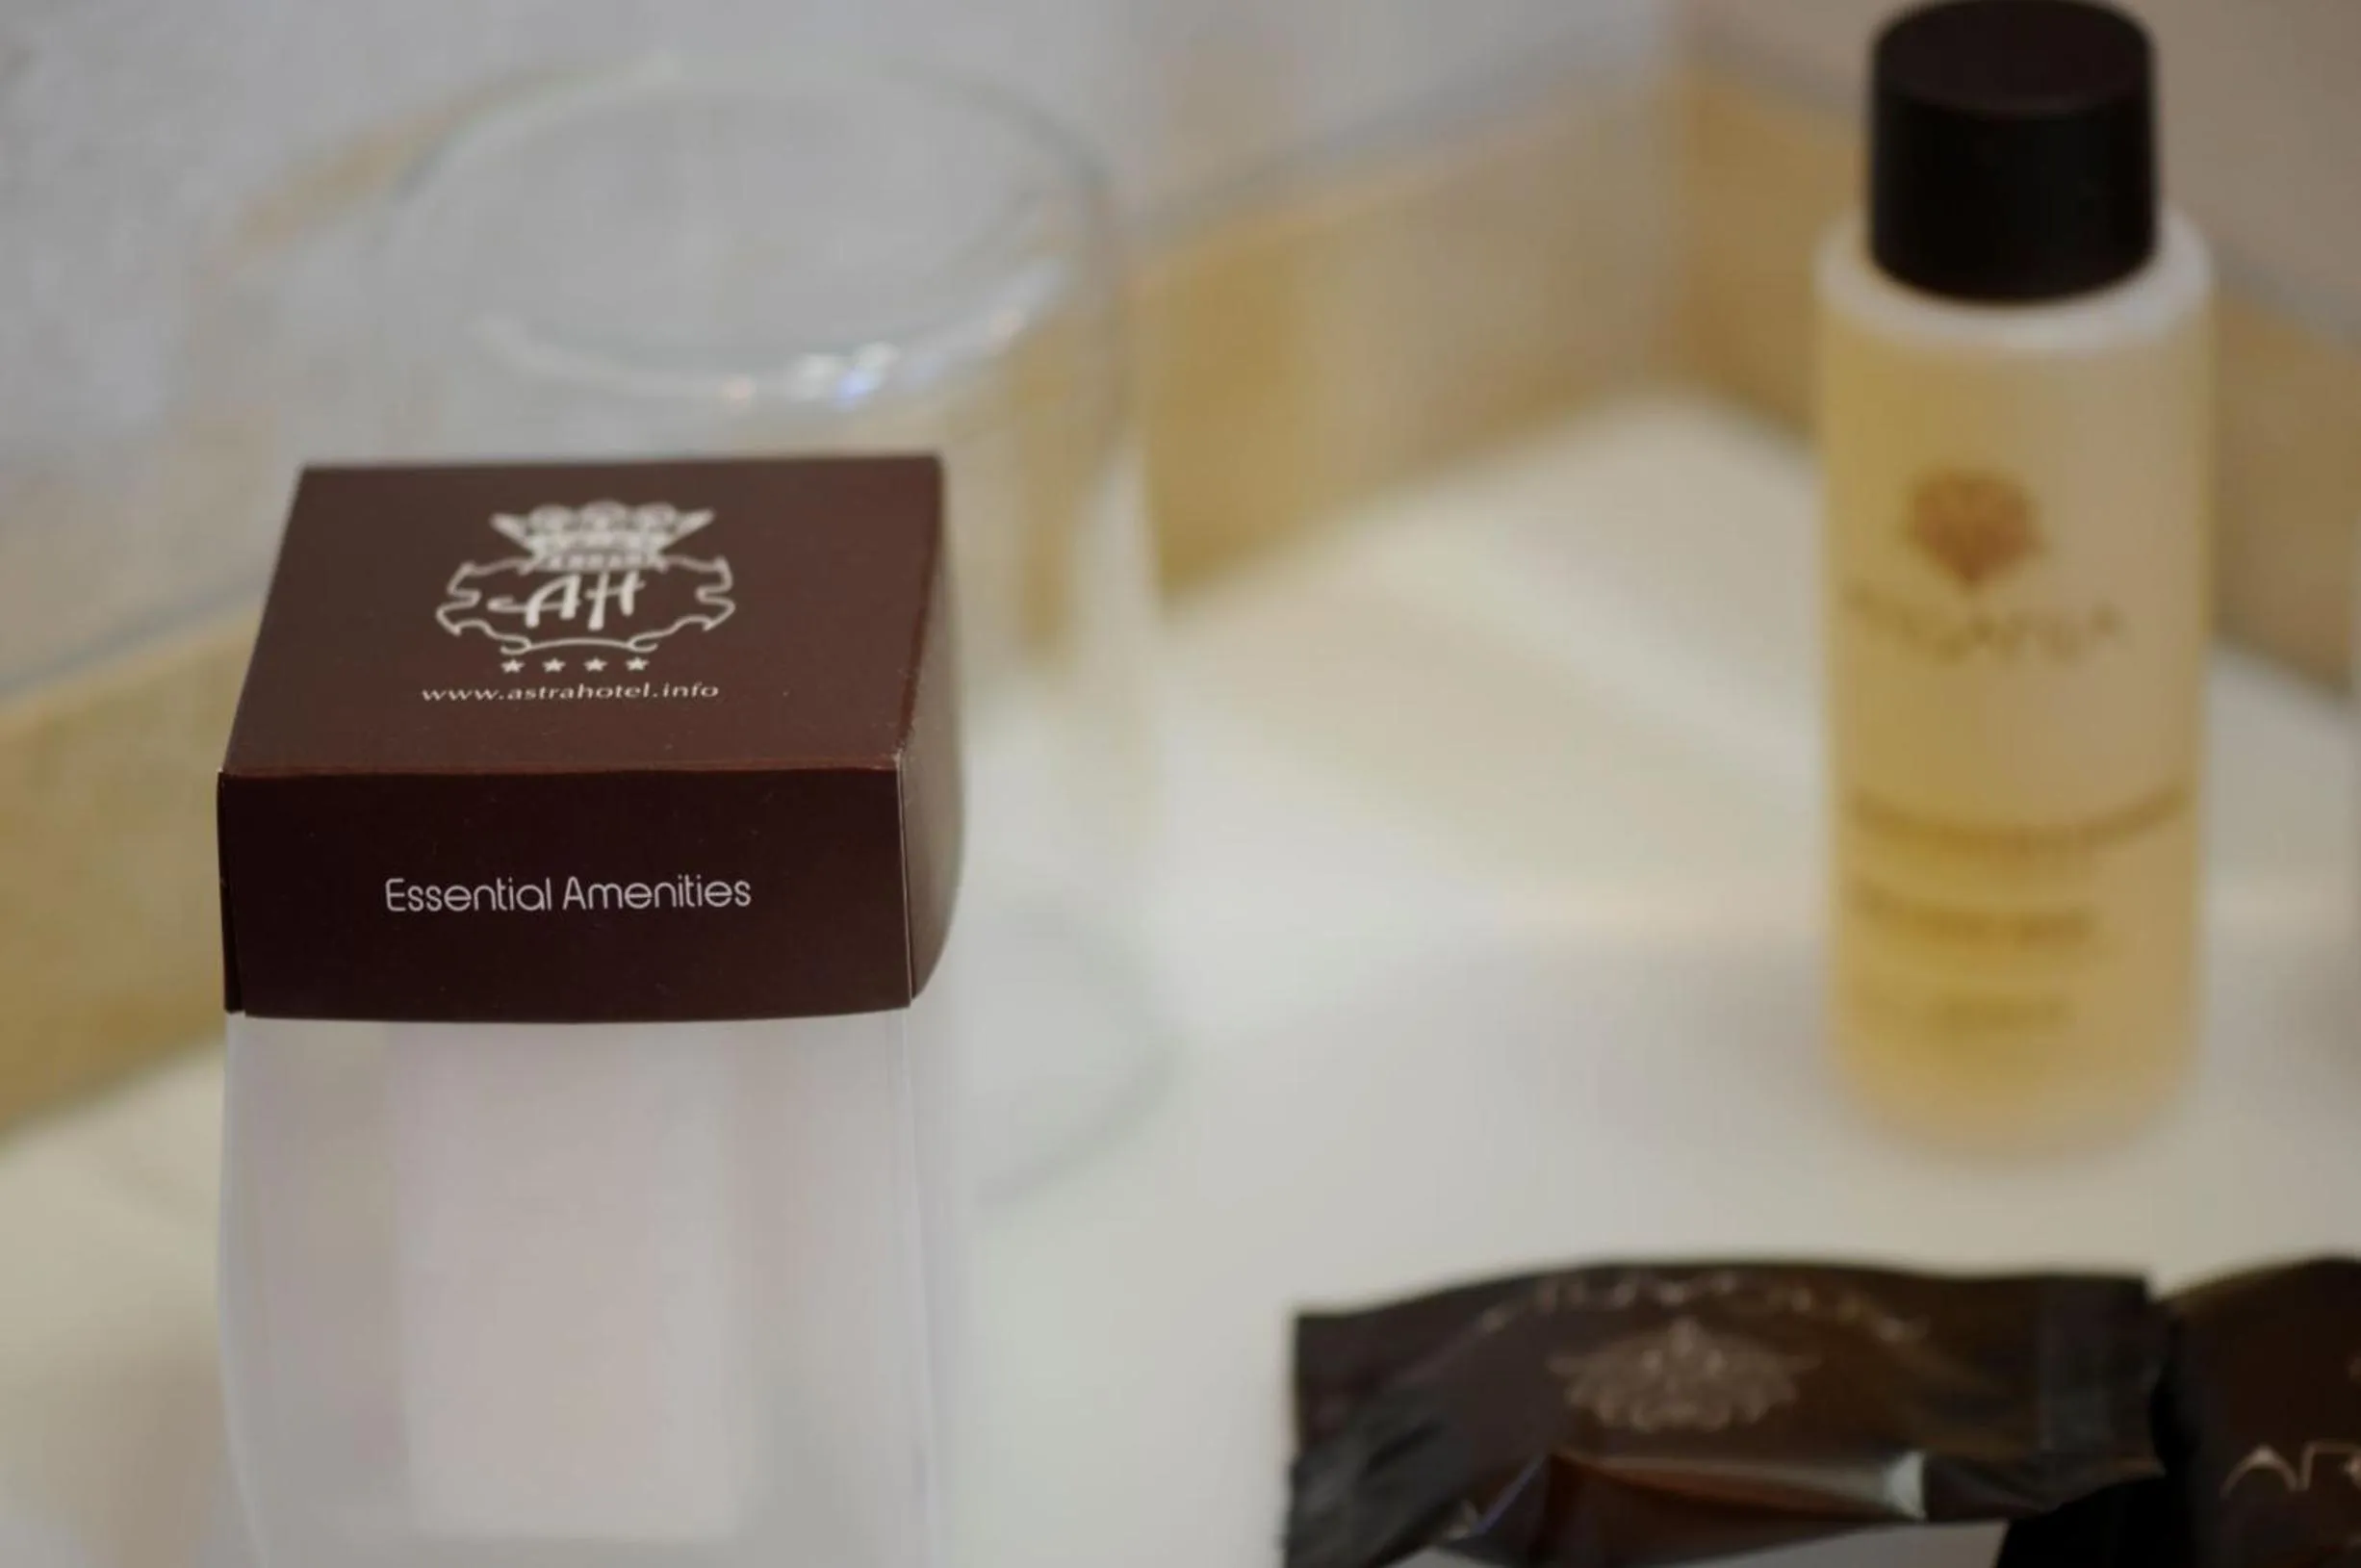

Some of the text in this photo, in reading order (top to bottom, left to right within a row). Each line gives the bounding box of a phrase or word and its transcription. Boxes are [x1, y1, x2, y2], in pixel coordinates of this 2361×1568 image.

[487, 572, 646, 630] AH
[421, 681, 720, 702] www.astrahotel.info
[385, 874, 752, 913] Essential Amenities
